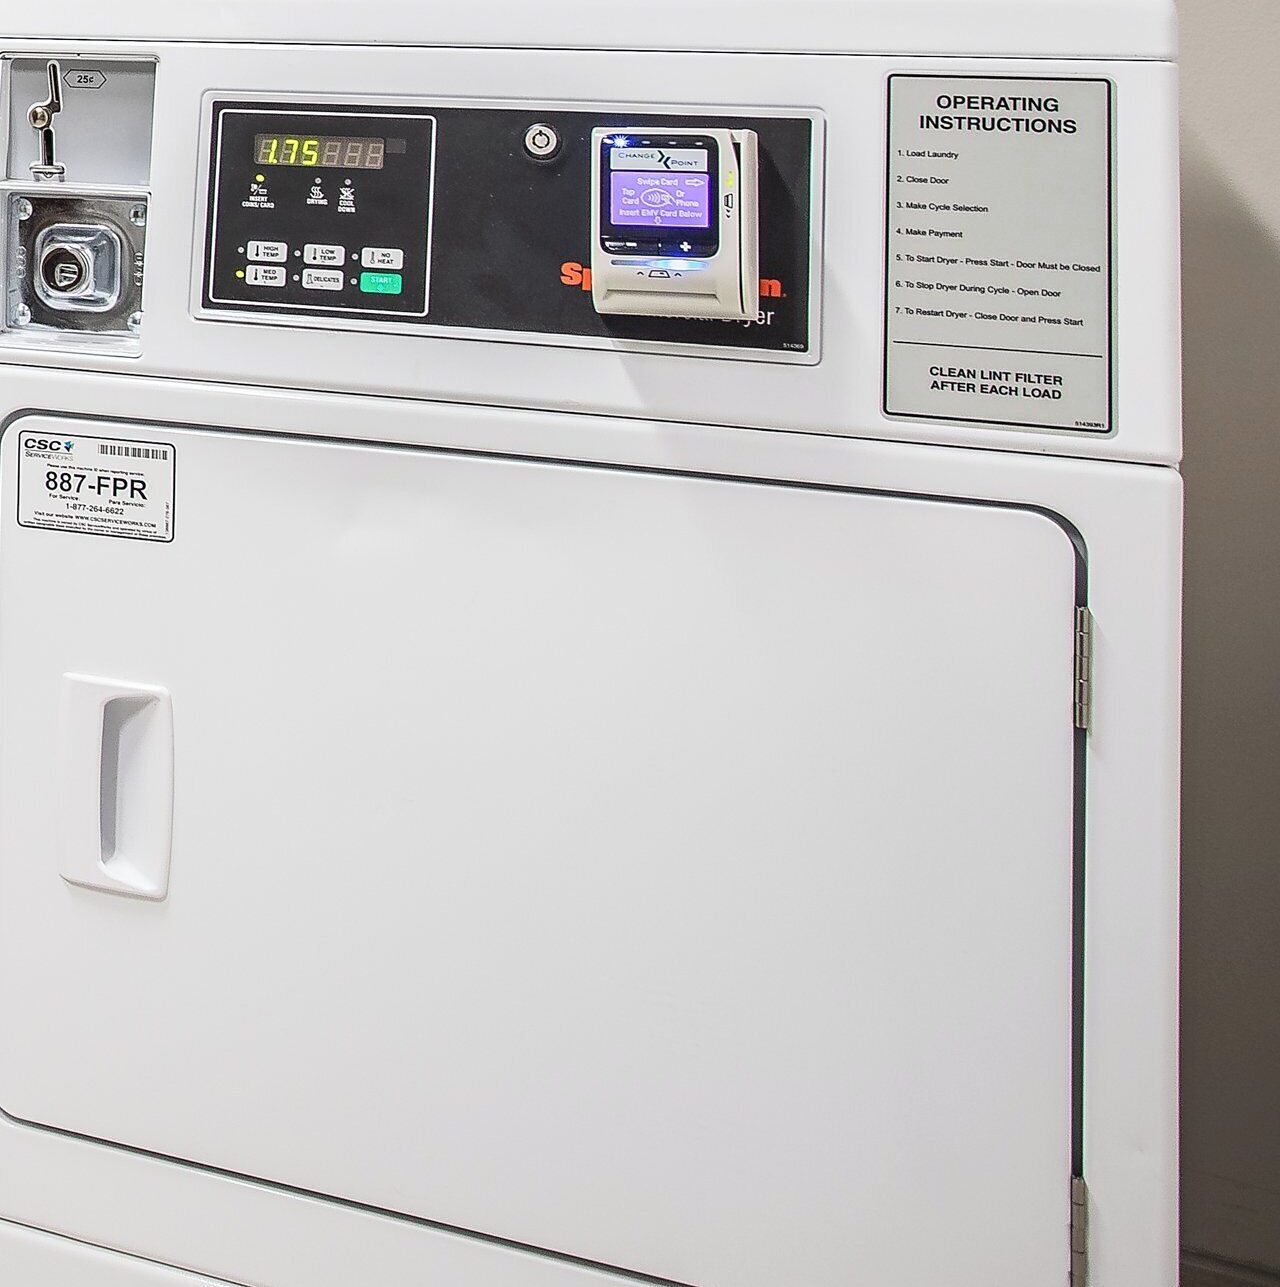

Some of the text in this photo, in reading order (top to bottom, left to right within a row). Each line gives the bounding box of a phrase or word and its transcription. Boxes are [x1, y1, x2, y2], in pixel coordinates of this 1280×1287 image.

[77, 75, 94, 85] 25¢
[936, 94, 1059, 112] OPERATING
[919, 115, 1079, 134] INSTRUCTIONS
[268, 139, 319, 166] 1.75
[897, 149, 959, 160] 1. Load Laundry
[637, 178, 678, 186] Swipe Card
[896, 174, 949, 184] 2. Close Door
[370, 276, 392, 284] START
[929, 365, 1063, 387] CLEAN LINT FILTER
[930, 379, 1062, 399] AFTER EACH LOAD
[23, 437, 61, 451] CSC
[45, 470, 147, 500] 887-FPR
[65, 502, 124, 515] 1-877-264-6622
